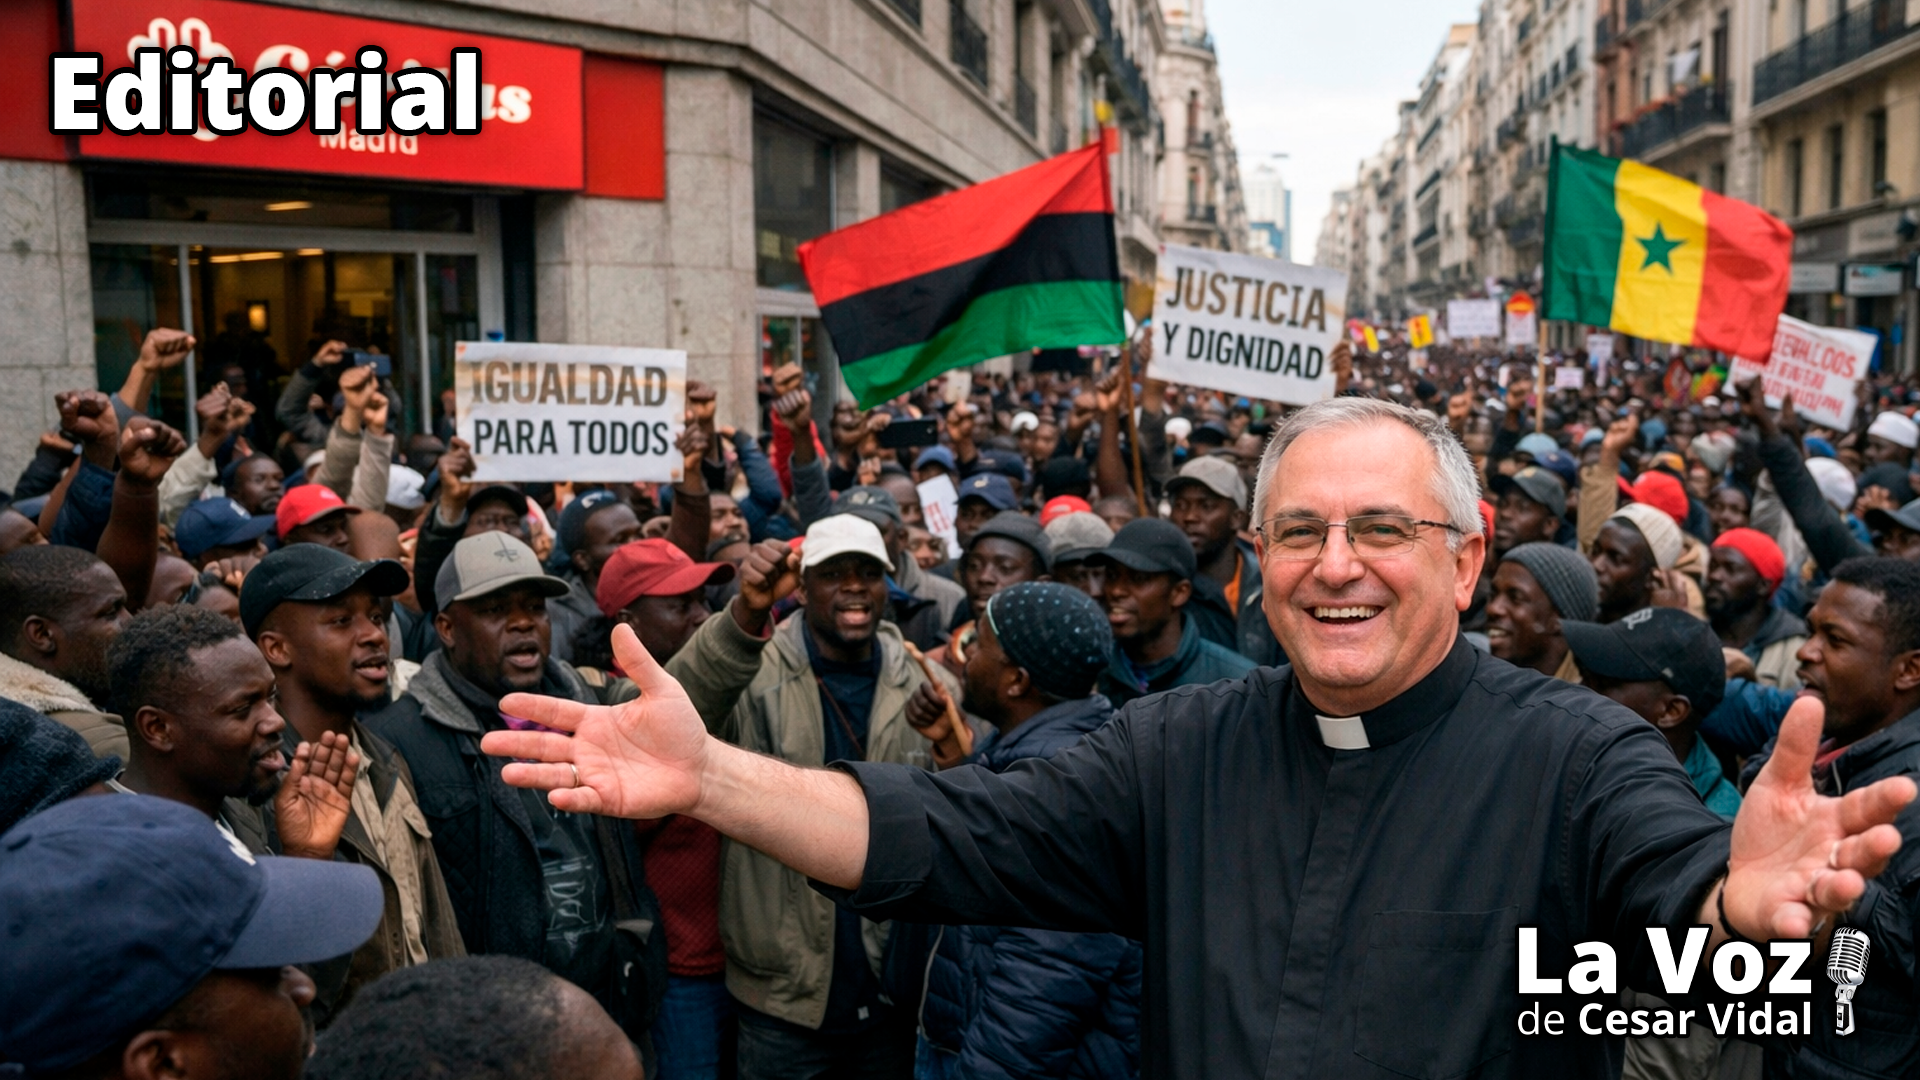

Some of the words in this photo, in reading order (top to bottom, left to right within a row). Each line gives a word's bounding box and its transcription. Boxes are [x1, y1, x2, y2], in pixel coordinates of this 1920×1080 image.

[1165, 266, 1326, 333] JUSTICIA
[1162, 321, 1181, 356] Y
[1186, 325, 1324, 381] DIGNIDAD
[470, 360, 668, 408] IGUALDAD
[473, 418, 559, 455] PARA
[568, 420, 670, 456] TODOS
